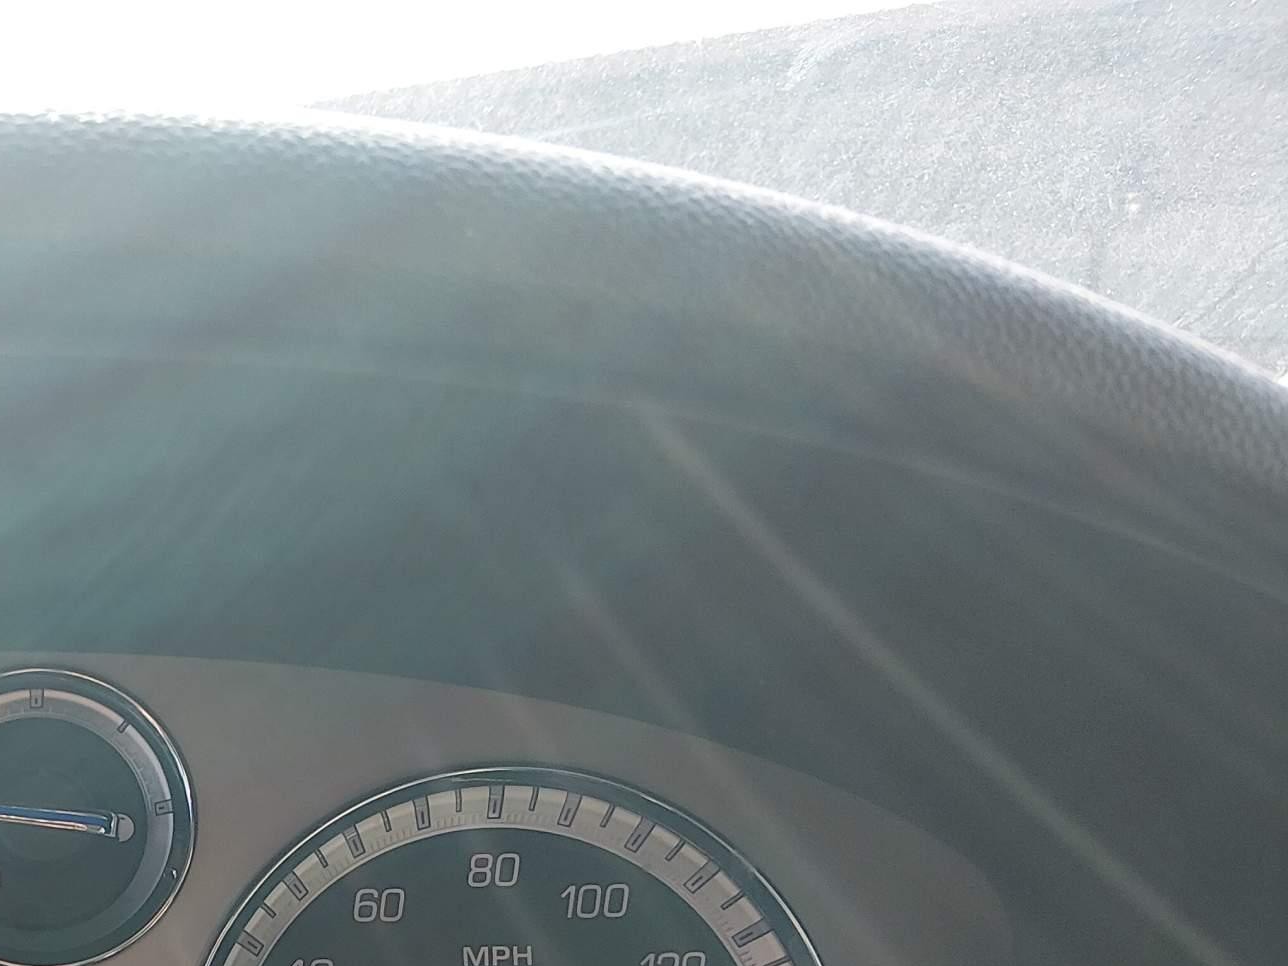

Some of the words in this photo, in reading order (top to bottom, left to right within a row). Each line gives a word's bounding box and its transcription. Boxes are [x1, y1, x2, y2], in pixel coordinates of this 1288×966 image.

[467, 853, 520, 888] 80
[352, 888, 405, 922] 60
[560, 883, 630, 919] 100
